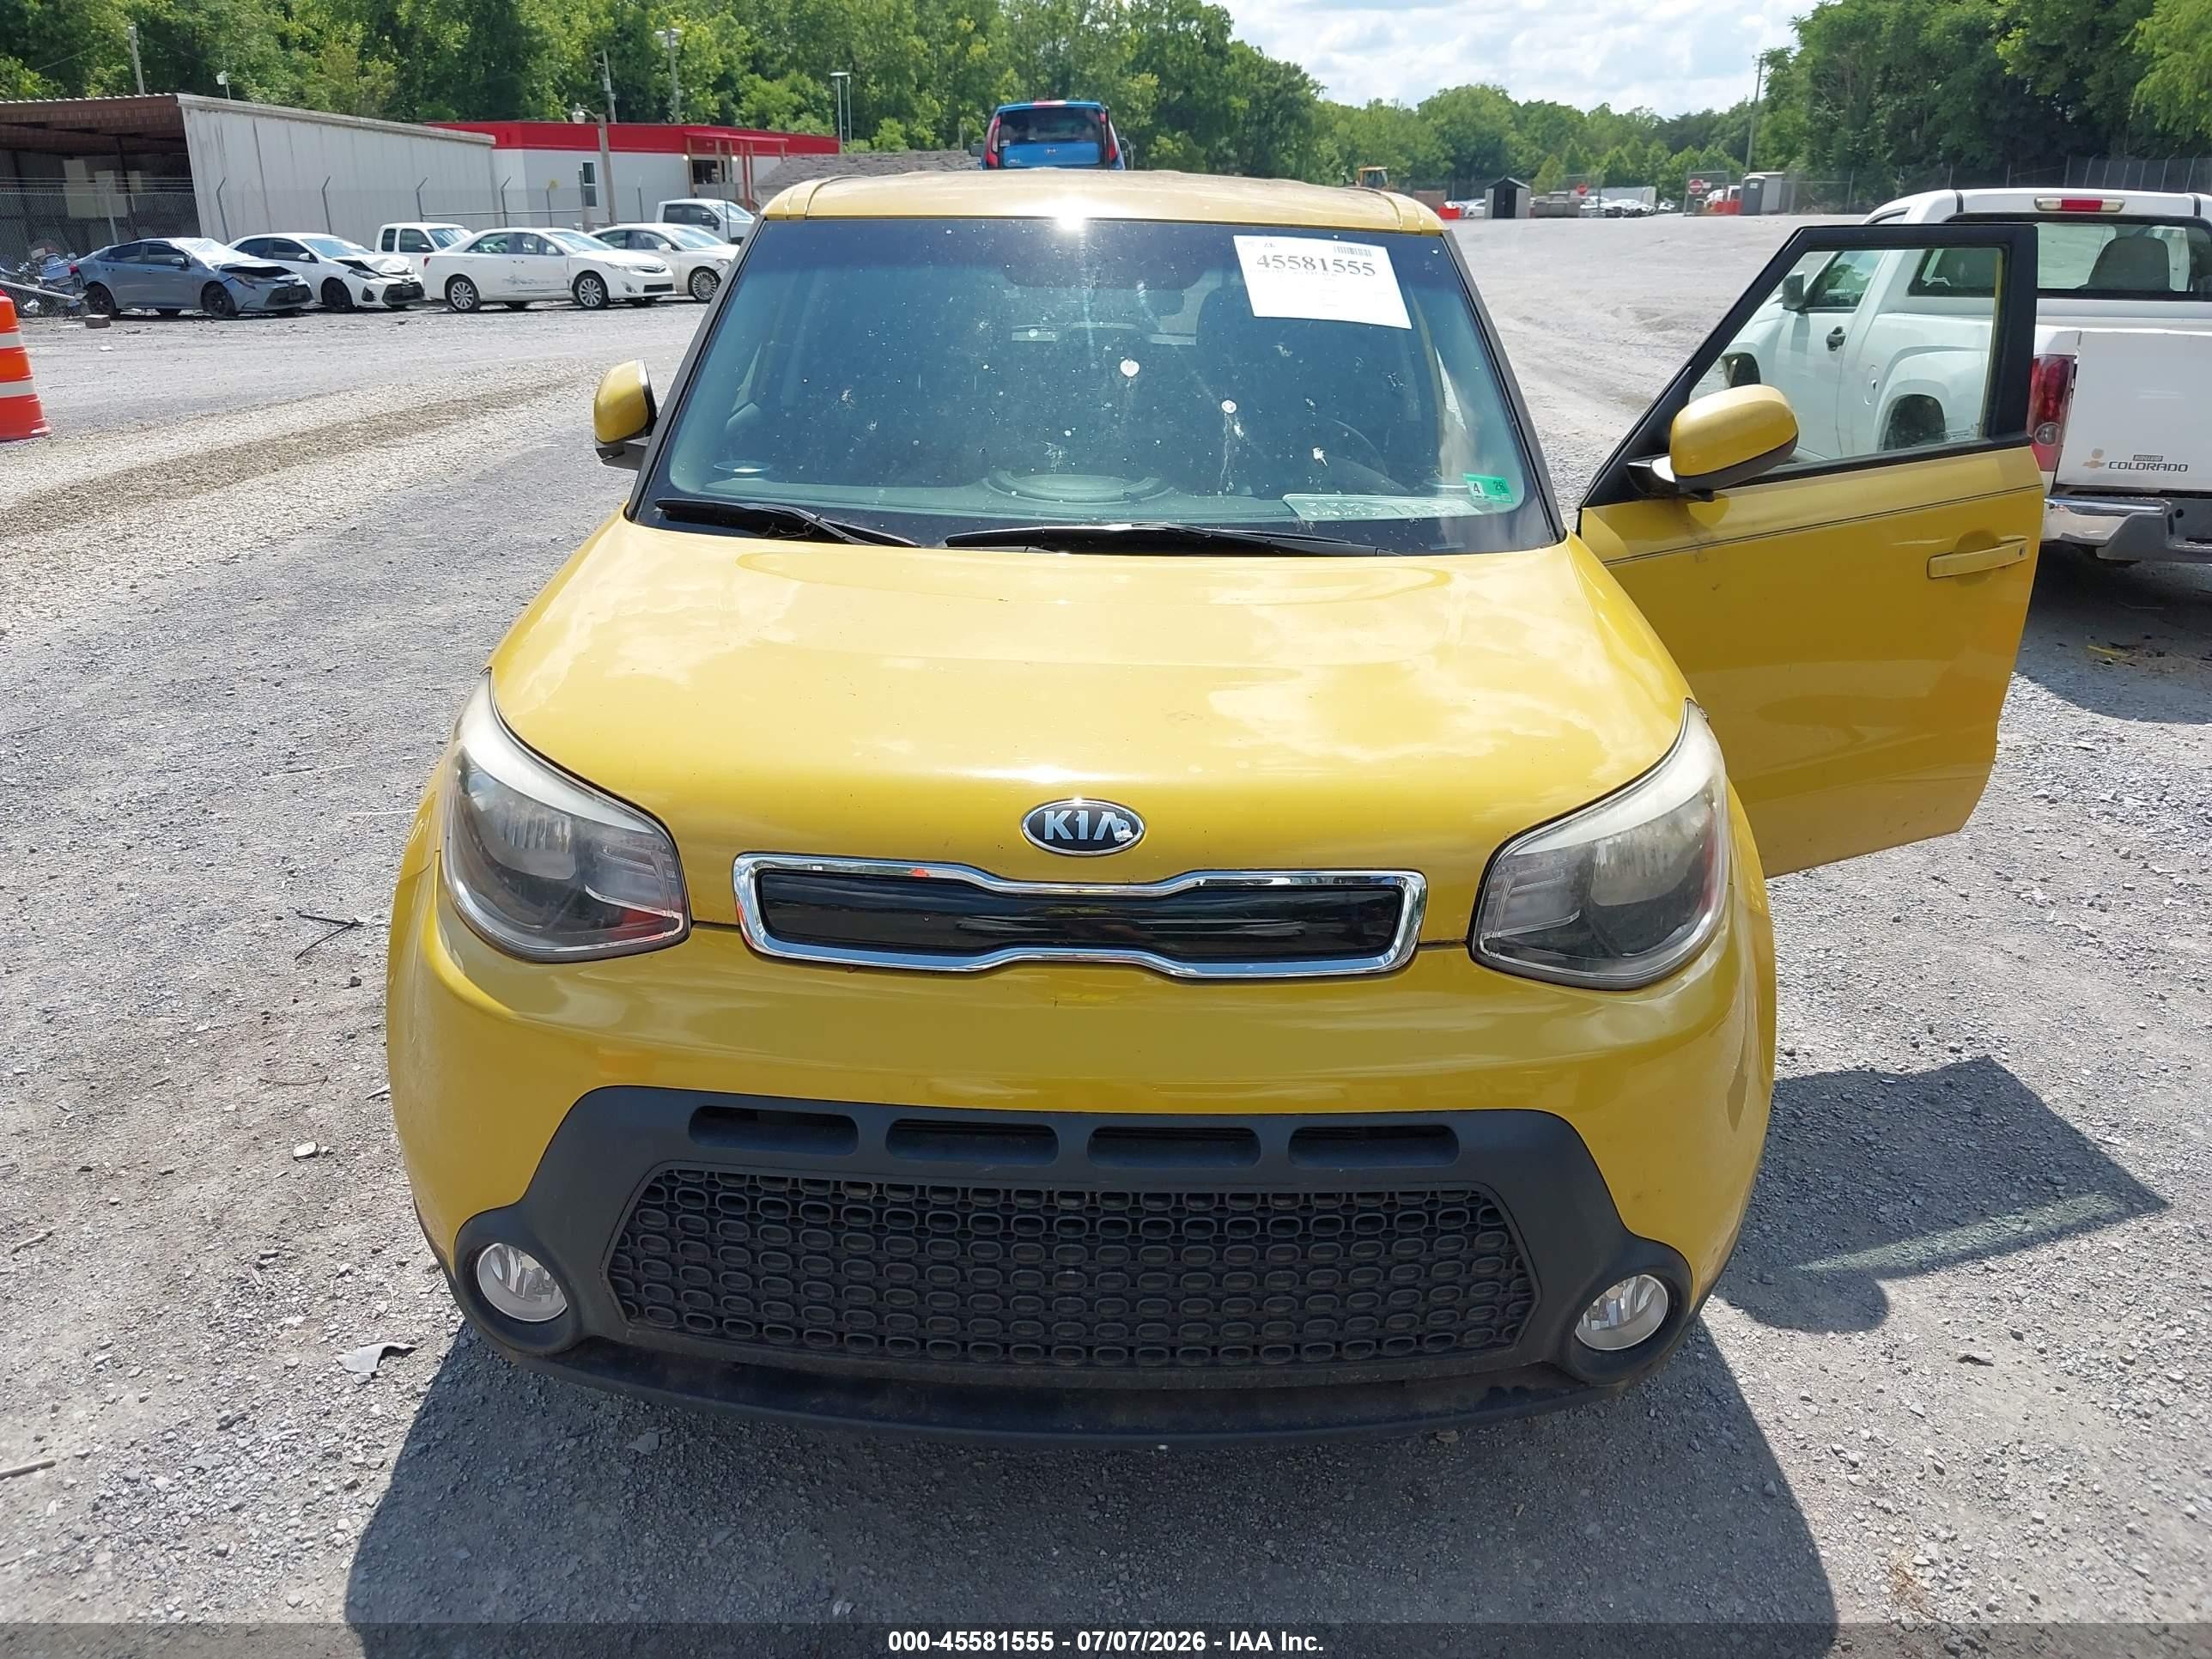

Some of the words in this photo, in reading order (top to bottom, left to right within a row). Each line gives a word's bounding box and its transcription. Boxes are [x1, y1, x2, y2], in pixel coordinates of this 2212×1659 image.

[1256, 254, 1376, 276] 45581555
[2108, 461, 2189, 472] COLORADO
[1043, 810, 1125, 841] KIA
